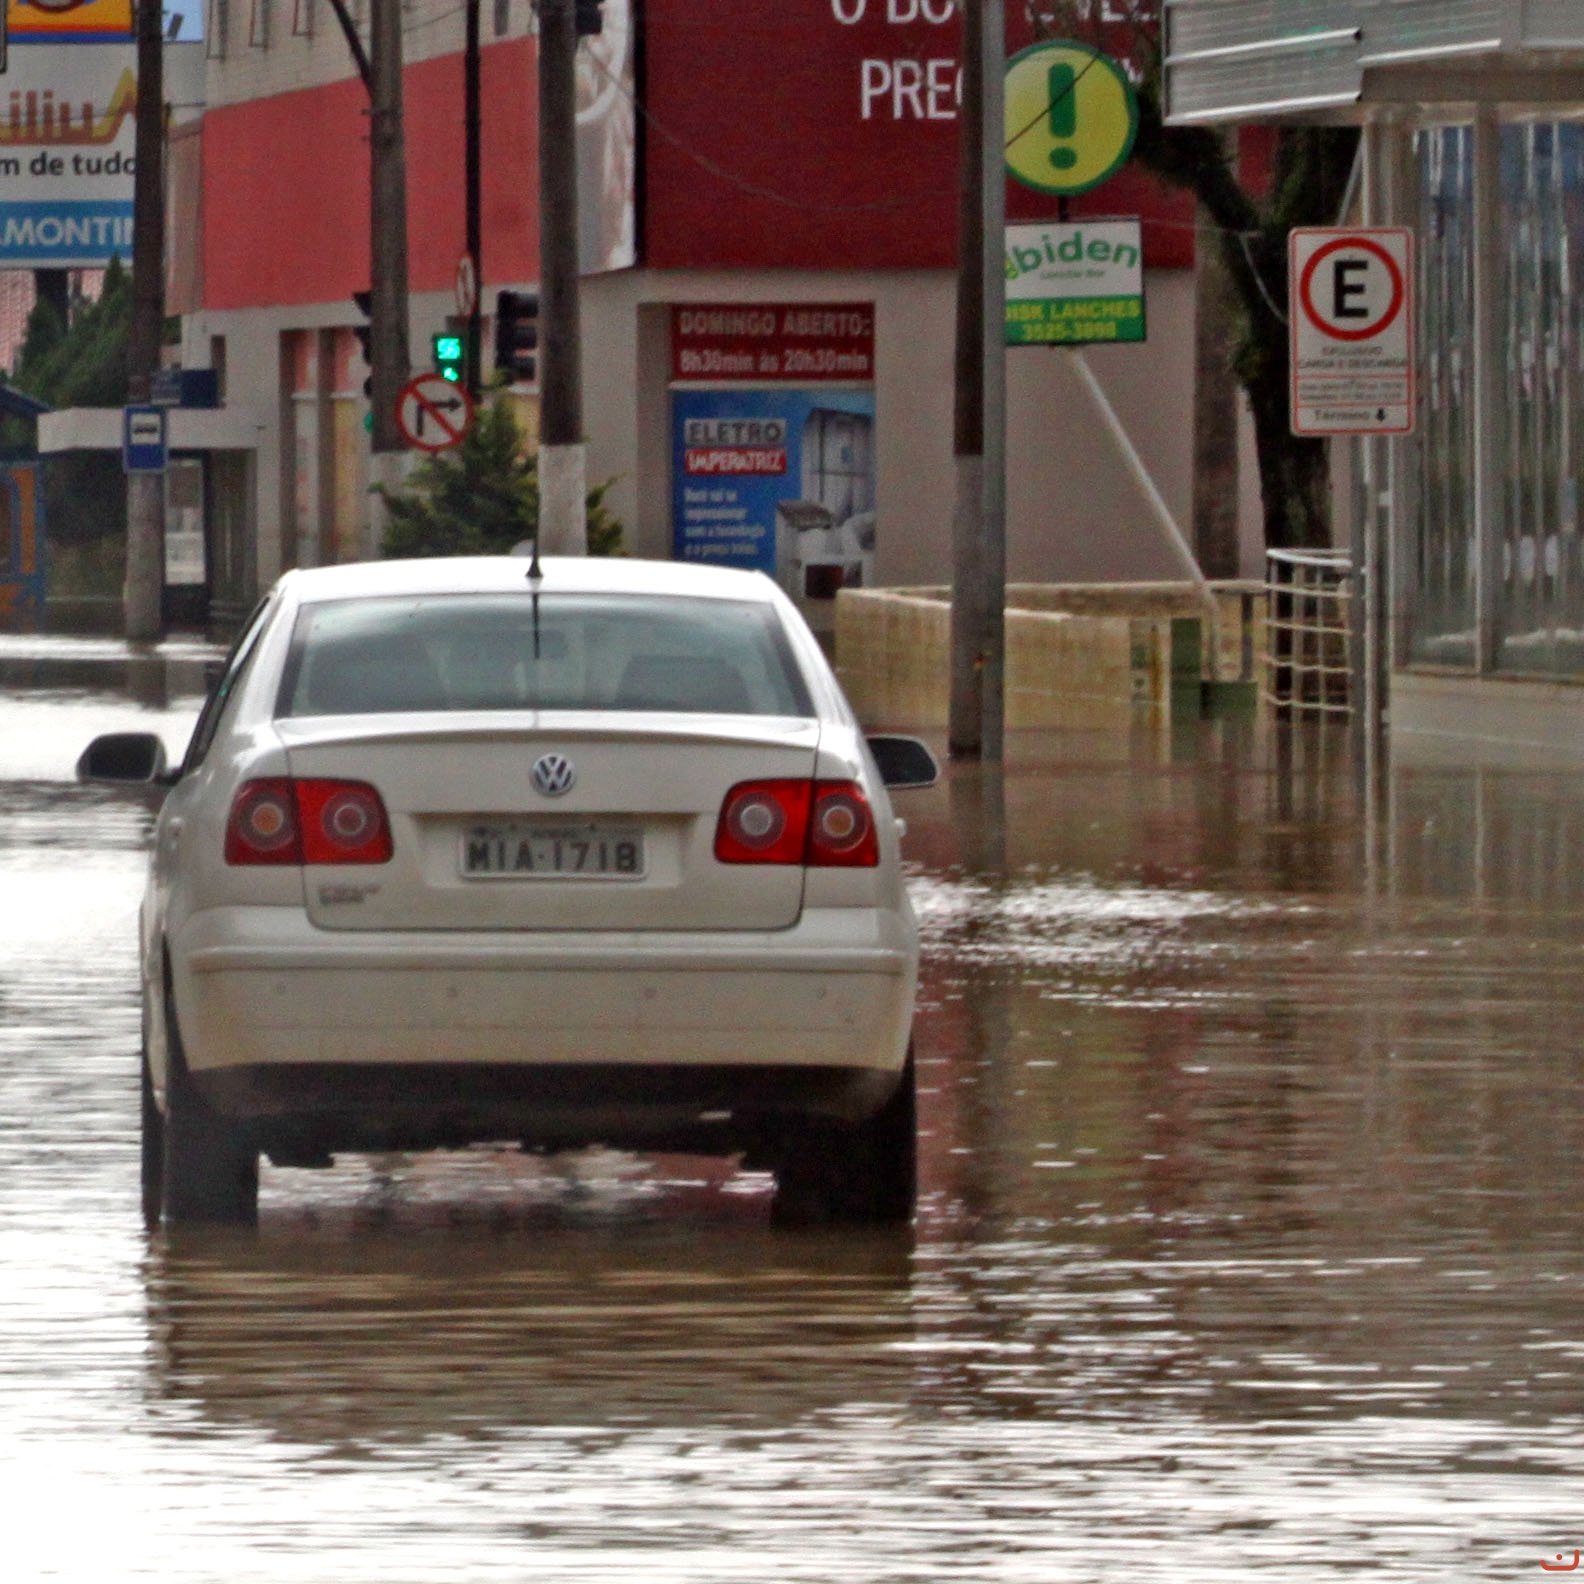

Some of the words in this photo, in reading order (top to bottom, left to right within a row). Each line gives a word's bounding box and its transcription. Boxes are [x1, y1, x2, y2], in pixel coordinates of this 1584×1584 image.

[861, 59, 962, 120] PRE
[30, 152, 64, 177] de
[1334, 260, 1369, 318] E
[1051, 300, 1141, 318] LANCHES
[681, 312, 775, 334] DOMINGO
[783, 313, 871, 336] ABERTO:
[681, 350, 753, 372] 8h30min
[784, 350, 868, 372] 20h30min
[687, 422, 783, 442] ELETRO
[688, 452, 784, 471] IMPERATRIZ
